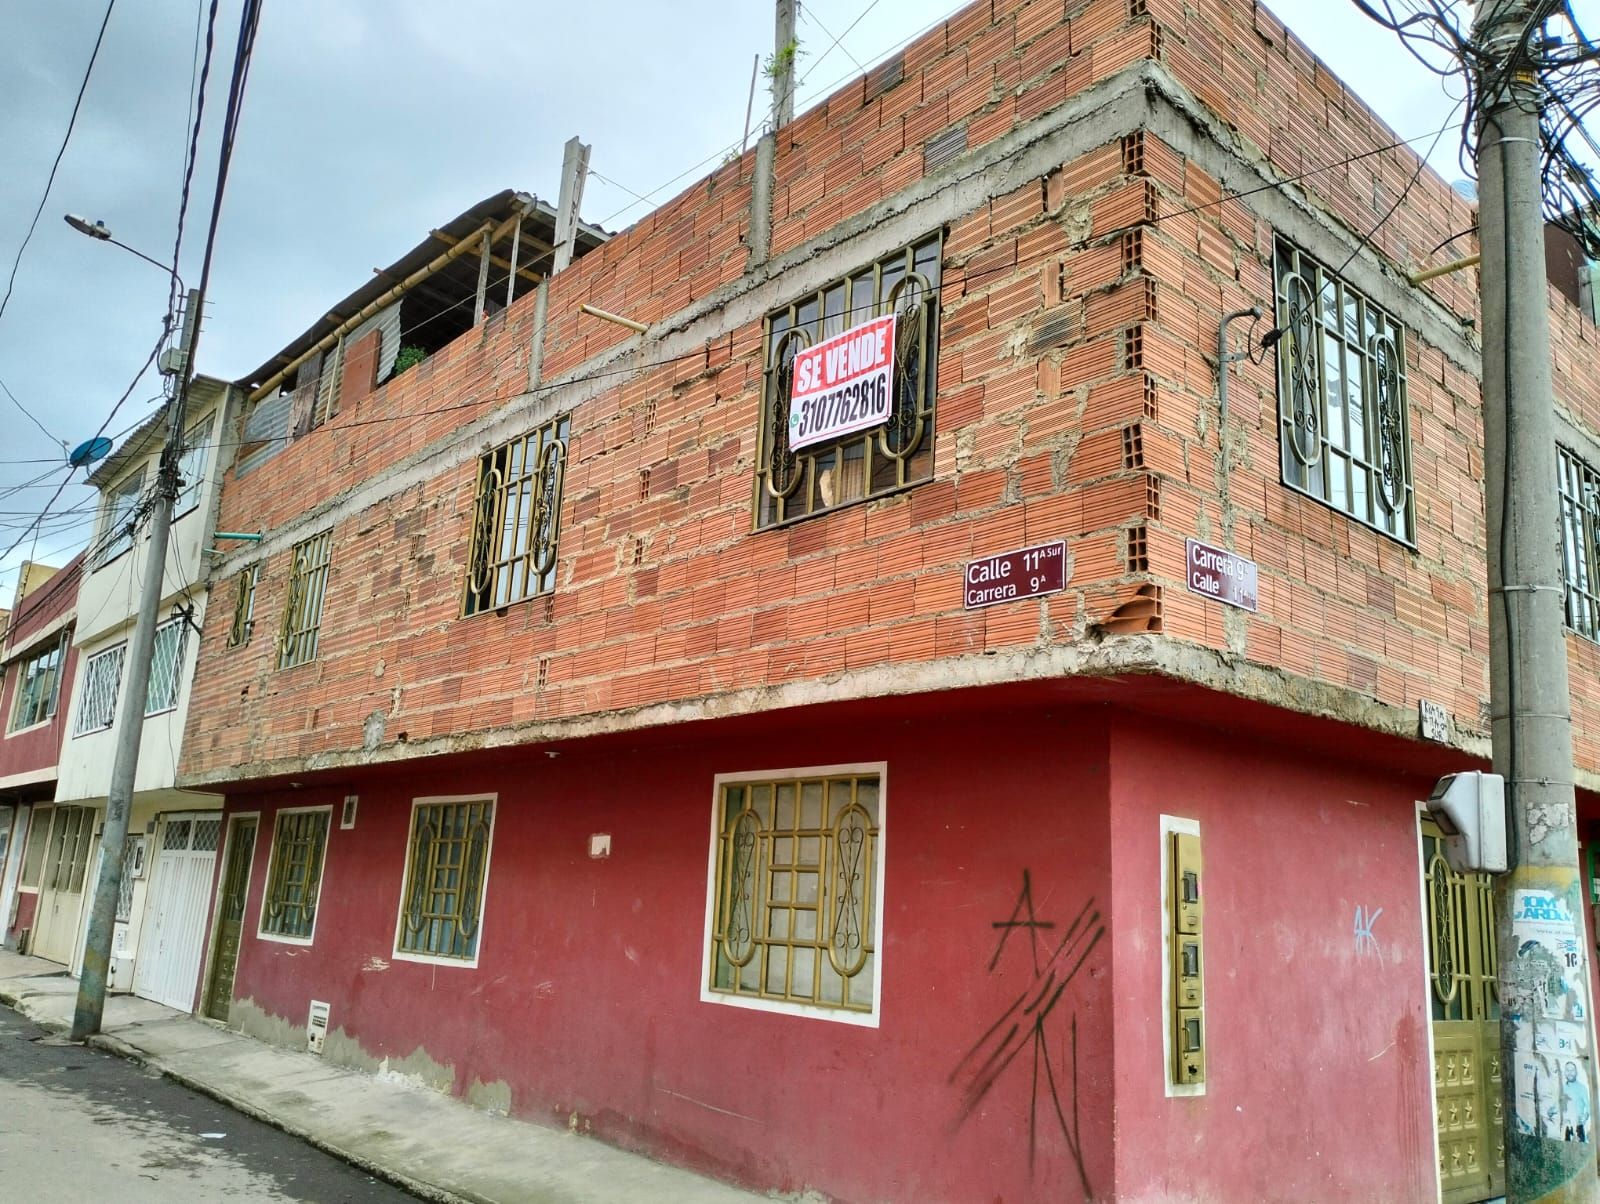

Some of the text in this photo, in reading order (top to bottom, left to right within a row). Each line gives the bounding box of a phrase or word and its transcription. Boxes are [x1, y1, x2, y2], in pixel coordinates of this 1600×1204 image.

[797, 327, 887, 393] SE VENDE
[799, 373, 886, 437] 3107762816
[968, 559, 1011, 584] Calle
[1193, 544, 1233, 576] Carrera
[968, 575, 1046, 605] Carrera 9A
[1193, 572, 1219, 594] Calle
